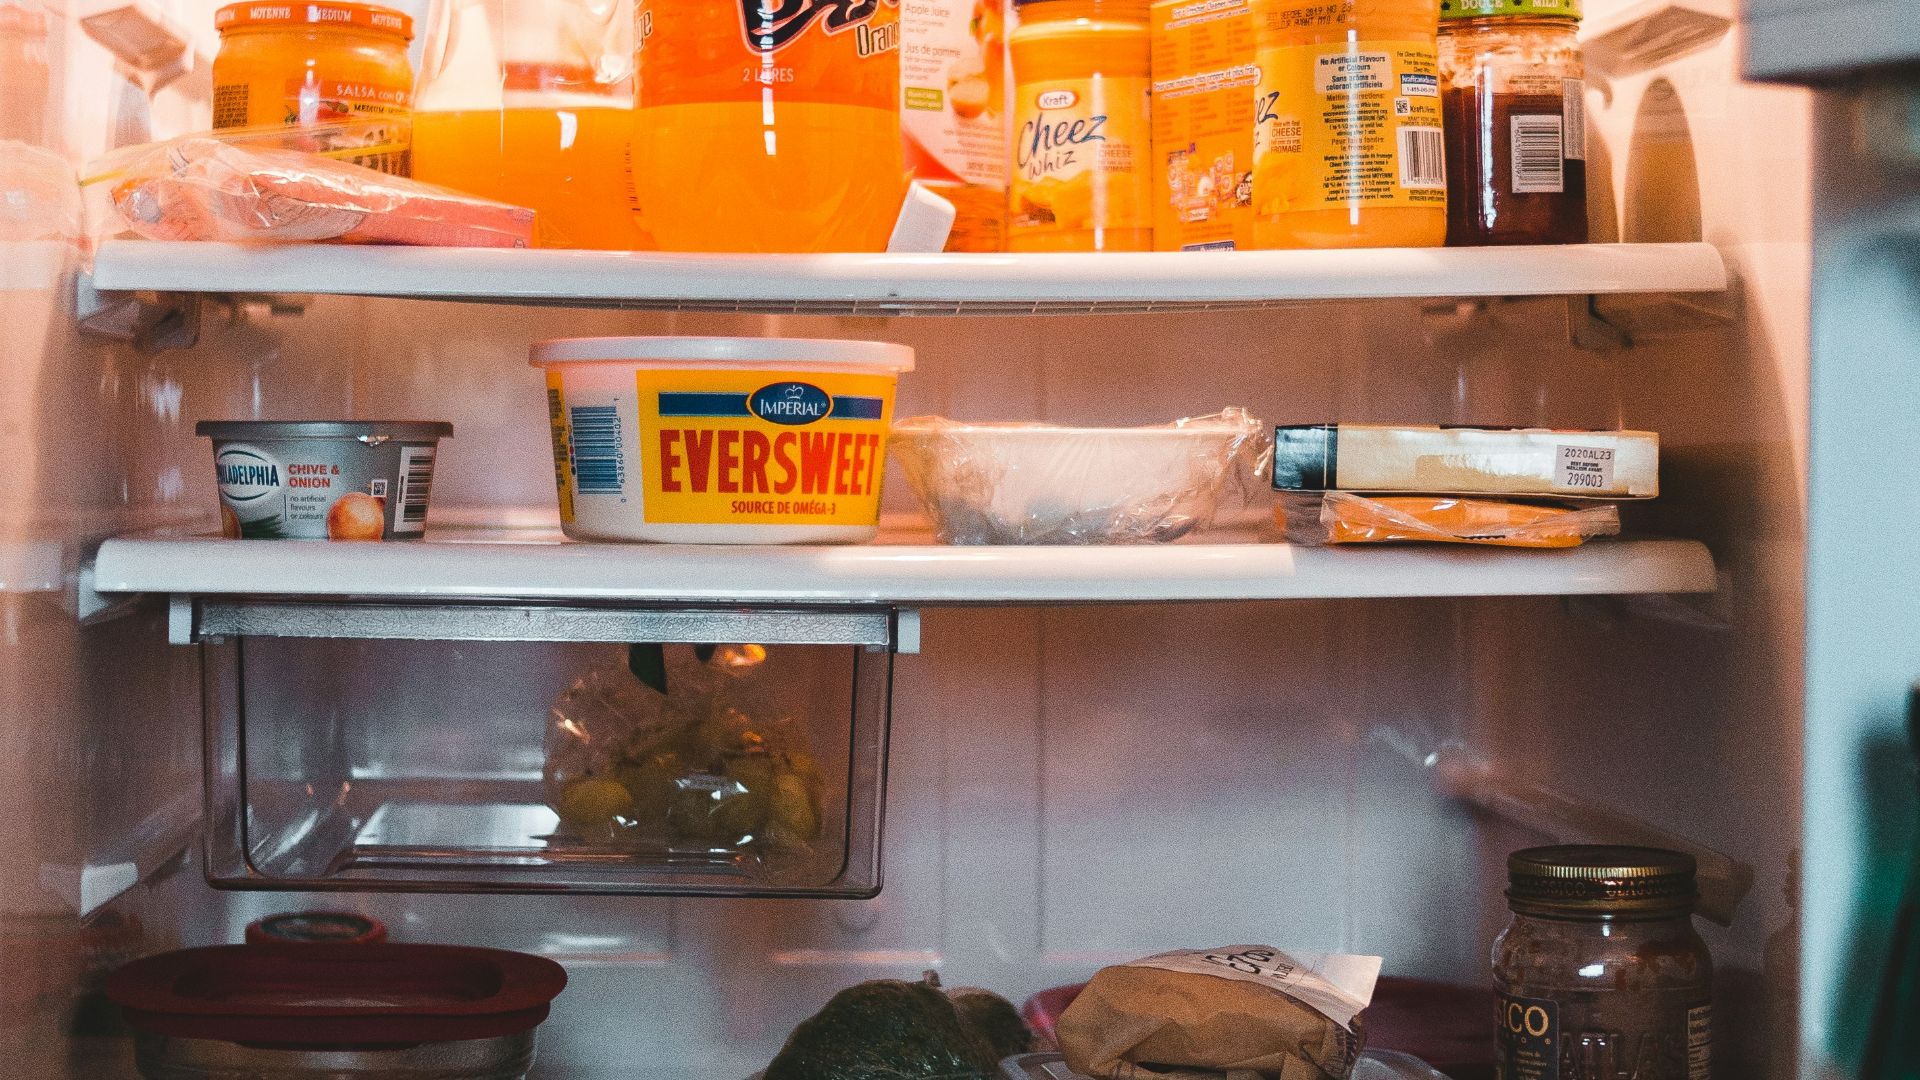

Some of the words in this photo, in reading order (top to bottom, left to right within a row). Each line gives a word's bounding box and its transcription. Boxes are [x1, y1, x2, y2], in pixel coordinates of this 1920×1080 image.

[250, 7, 291, 19] MOYENNE
[905, 3, 929, 16] Apple
[905, 41, 919, 54] Jus
[922, 44, 930, 55] de
[932, 48, 961, 59] pomme
[1320, 58, 1329, 66] No
[1330, 56, 1357, 65] Artificial
[1359, 55, 1386, 63] Flavours
[743, 68, 750, 82] 2
[754, 68, 794, 82] LRES
[1331, 75, 1347, 83] Sans
[336, 83, 376, 99] SALSA
[1042, 94, 1068, 107] Kraft
[1271, 127, 1302, 138] CHEESE
[1017, 111, 1107, 170] Cheez
[1271, 145, 1302, 154] FROMAGE
[760, 398, 822, 416] IMPERIAL
[1564, 448, 1612, 460] 2020AL23
[659, 428, 879, 497] EVERSWEET
[288, 464, 328, 476] CHIVE
[330, 464, 340, 476] &
[288, 478, 331, 489] ONION
[1567, 472, 1603, 488] 299003
[731, 500, 775, 515] SOURCE
[777, 501, 791, 515] DE
[793, 499, 836, 516] OMÉGA-3
